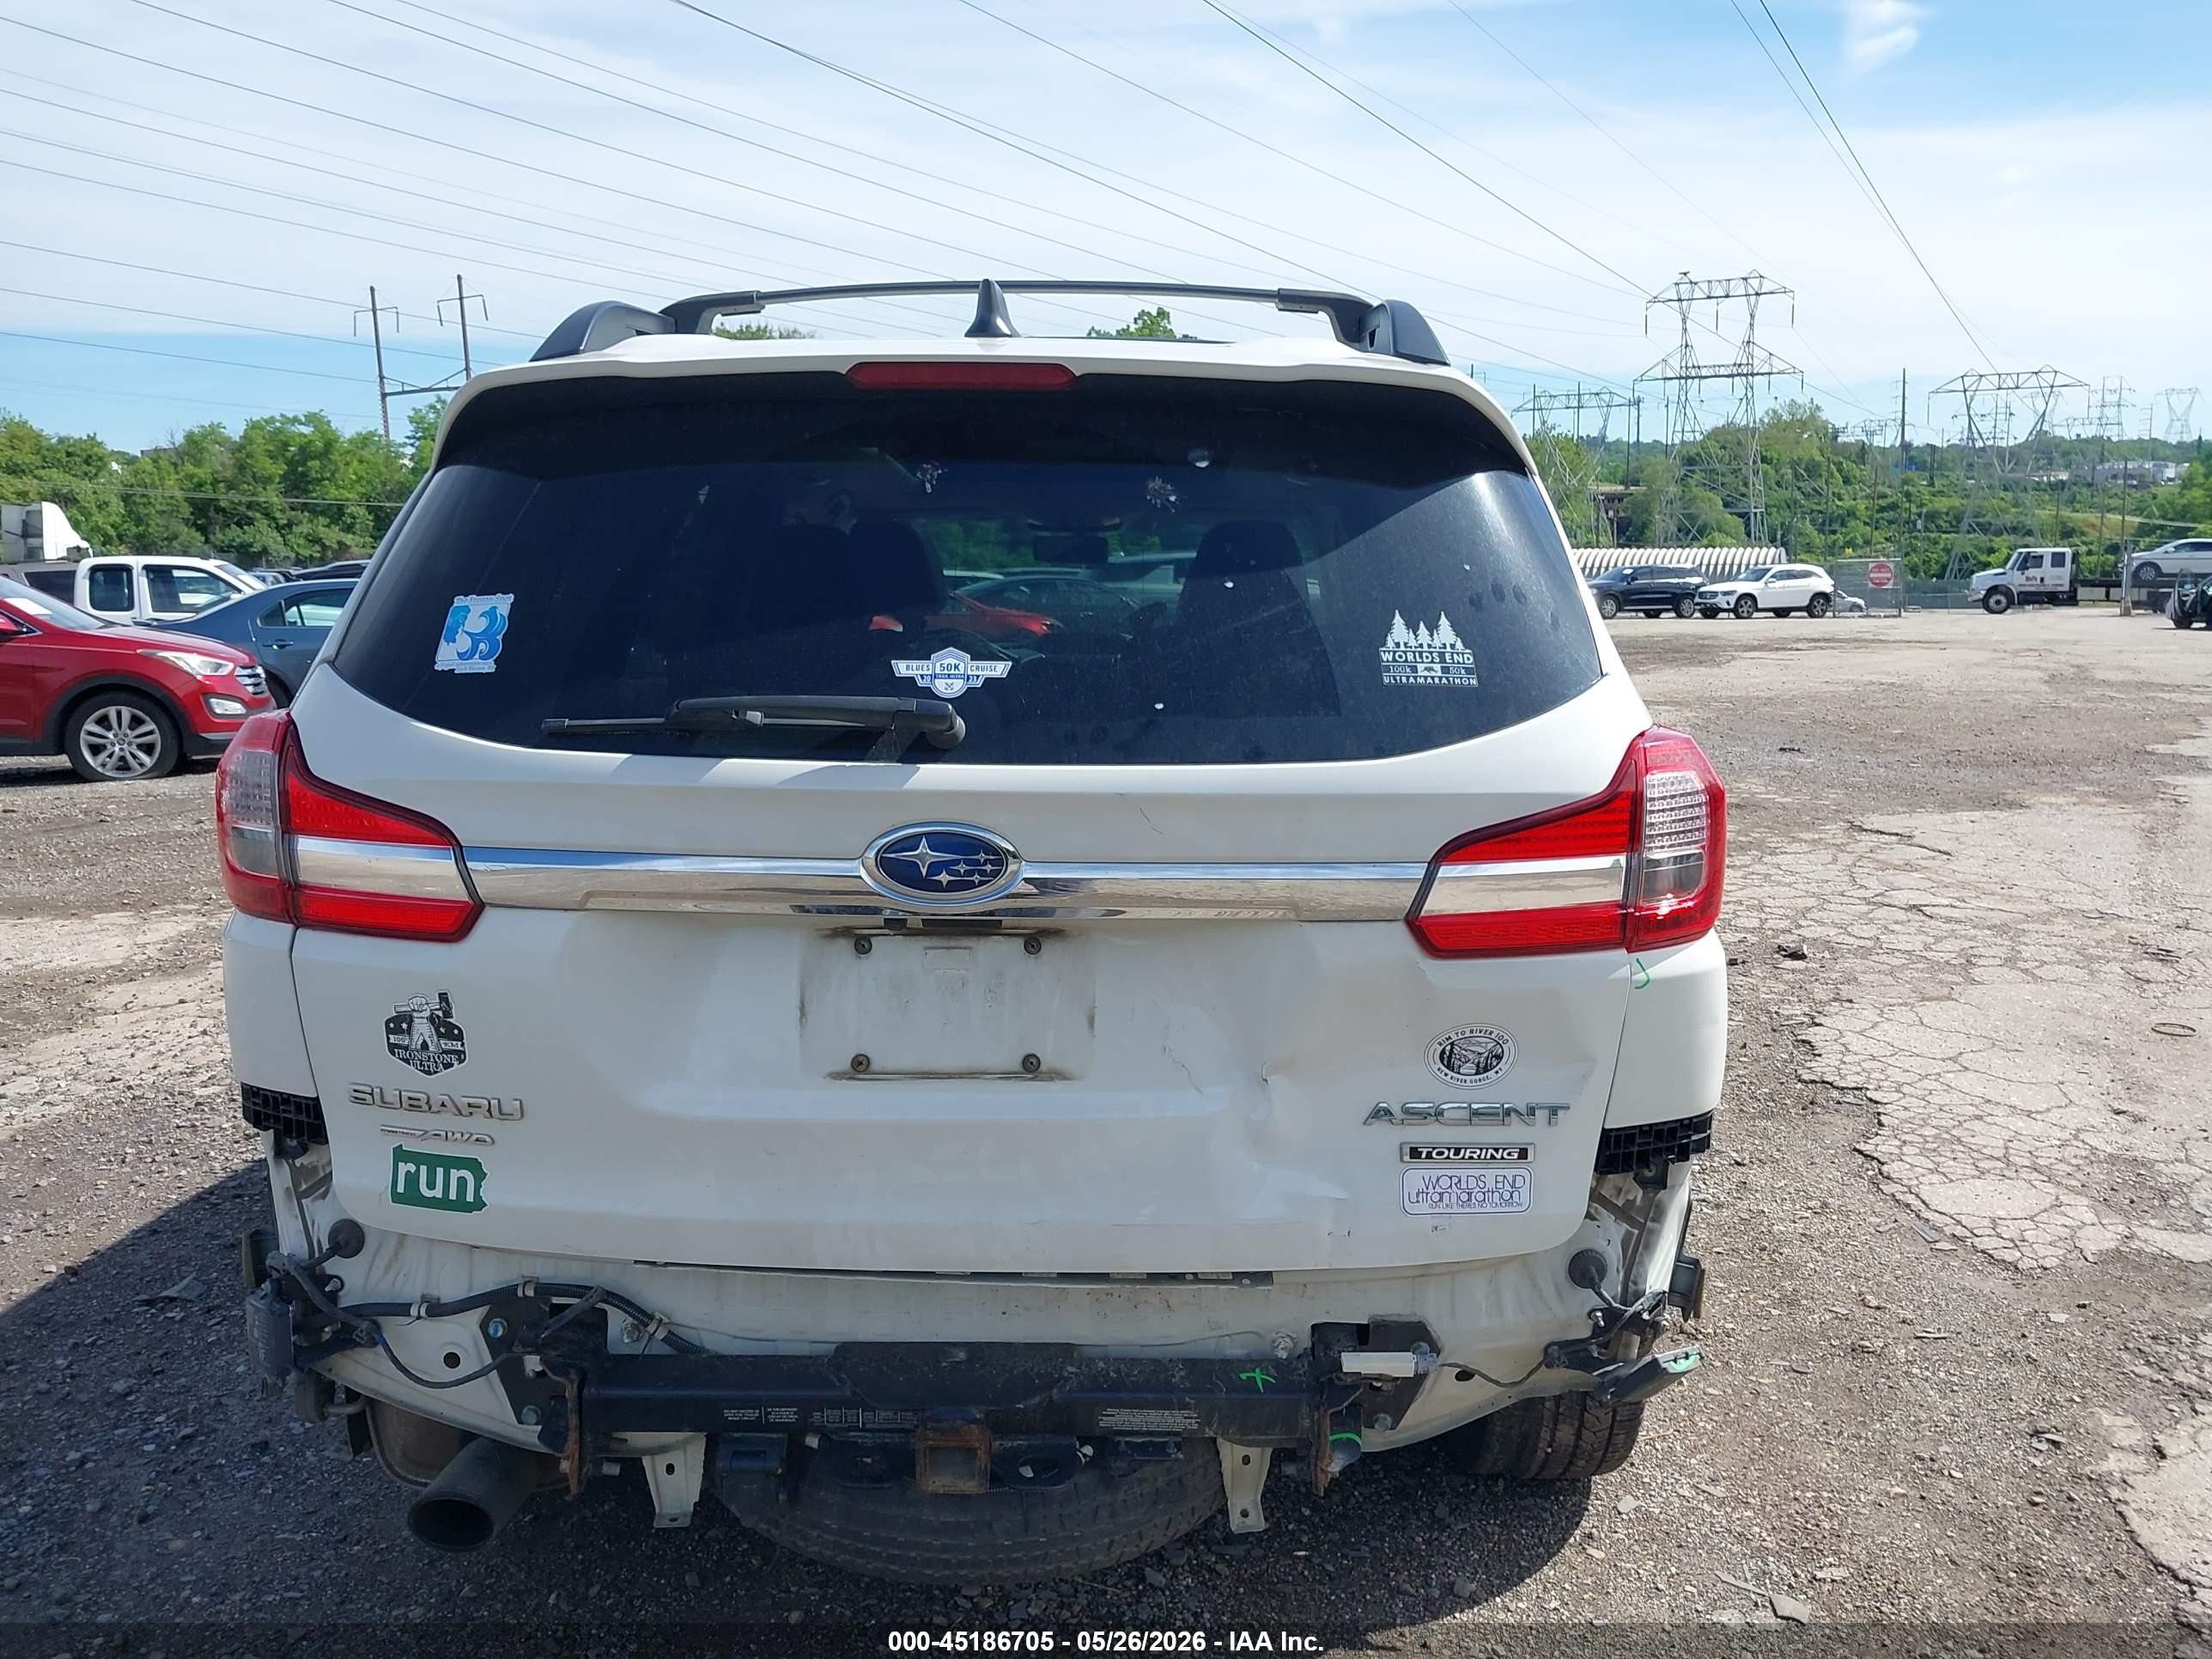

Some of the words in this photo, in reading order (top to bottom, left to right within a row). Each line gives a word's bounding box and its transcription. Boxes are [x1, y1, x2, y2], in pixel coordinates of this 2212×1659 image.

[1380, 651, 1440, 663] WORLDS
[1444, 653, 1474, 664] END
[939, 663, 961, 672] 50K
[1383, 676, 1477, 686] ULTRAMARATHON
[1437, 1036, 1453, 1048] RIM
[1454, 1030, 1466, 1038] TO
[1469, 1028, 1494, 1036] RIVER
[1494, 1032, 1510, 1045] 100
[394, 1048, 459, 1064] IRONSTONE
[410, 1060, 445, 1072] ULTRA
[349, 1082, 525, 1121] SUBARU
[1363, 1101, 1571, 1127] ASCENT
[425, 1129, 495, 1146] AWD
[1417, 1147, 1521, 1159] TOURING
[396, 1160, 475, 1203] run
[1422, 1174, 1486, 1190] WORLDS
[1494, 1174, 1526, 1190] END
[1407, 1187, 1522, 1204] ultramarathon
